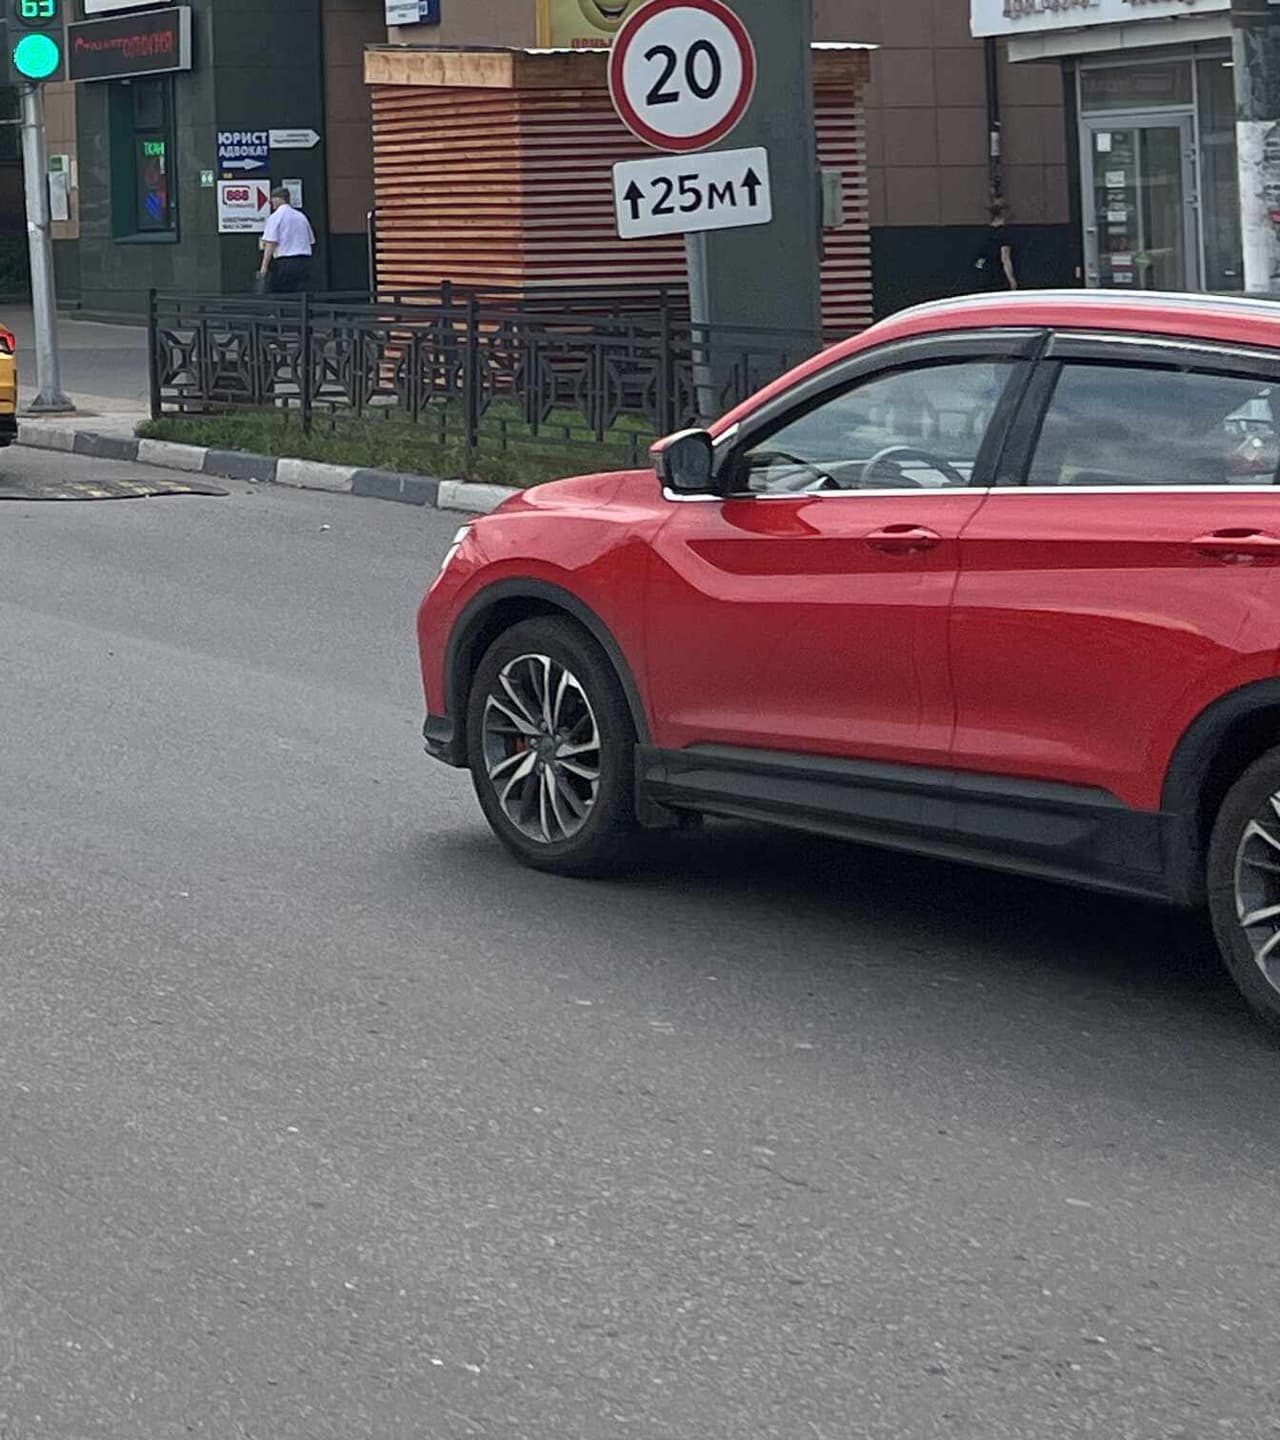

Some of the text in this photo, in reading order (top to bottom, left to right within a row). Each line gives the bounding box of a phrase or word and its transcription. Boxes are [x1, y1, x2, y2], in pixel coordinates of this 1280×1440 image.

[643, 39, 722, 106] 20
[217, 131, 269, 145] ЮРИСТ
[218, 145, 269, 158] АДВОКАТ
